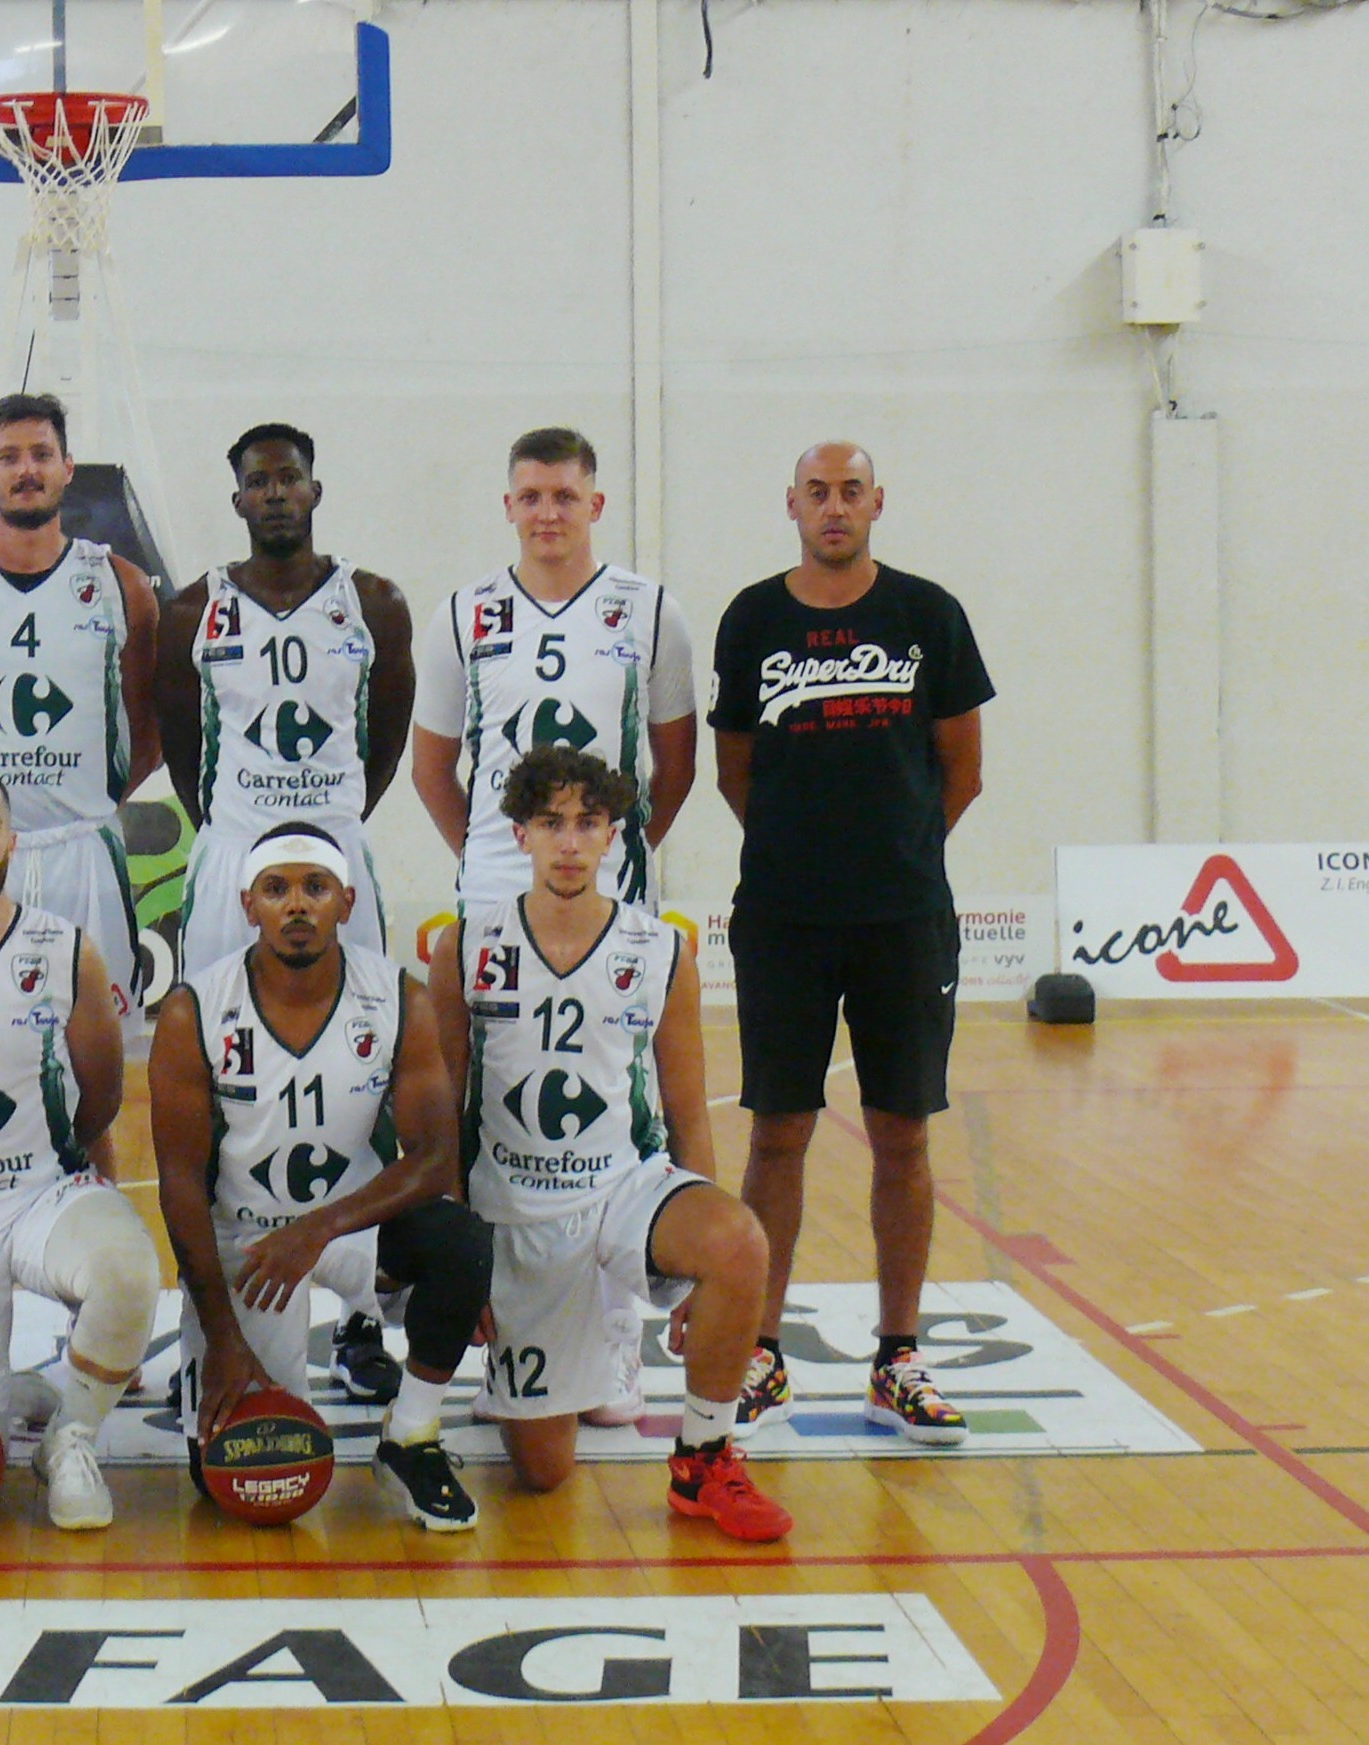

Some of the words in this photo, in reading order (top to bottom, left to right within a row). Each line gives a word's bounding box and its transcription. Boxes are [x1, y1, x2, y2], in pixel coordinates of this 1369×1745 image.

[11, 612, 41, 658] 4
[807, 629, 860, 648] REAL
[260, 635, 308, 686] 10
[535, 634, 566, 682] 5
[237, 768, 345, 790] Carrefour
[254, 791, 331, 808] contact
[956, 908, 1026, 925] rmonie
[963, 925, 1026, 941] tuelle
[1073, 901, 1239, 965] icone
[533, 996, 585, 1053] 12
[279, 1073, 324, 1129] 11
[493, 1142, 613, 1174] Carrefour
[509, 1173, 597, 1191] contact
[499, 1346, 548, 1398] 12
[223, 1433, 314, 1463] SPALDING
[232, 1471, 311, 1493] LEGACY
